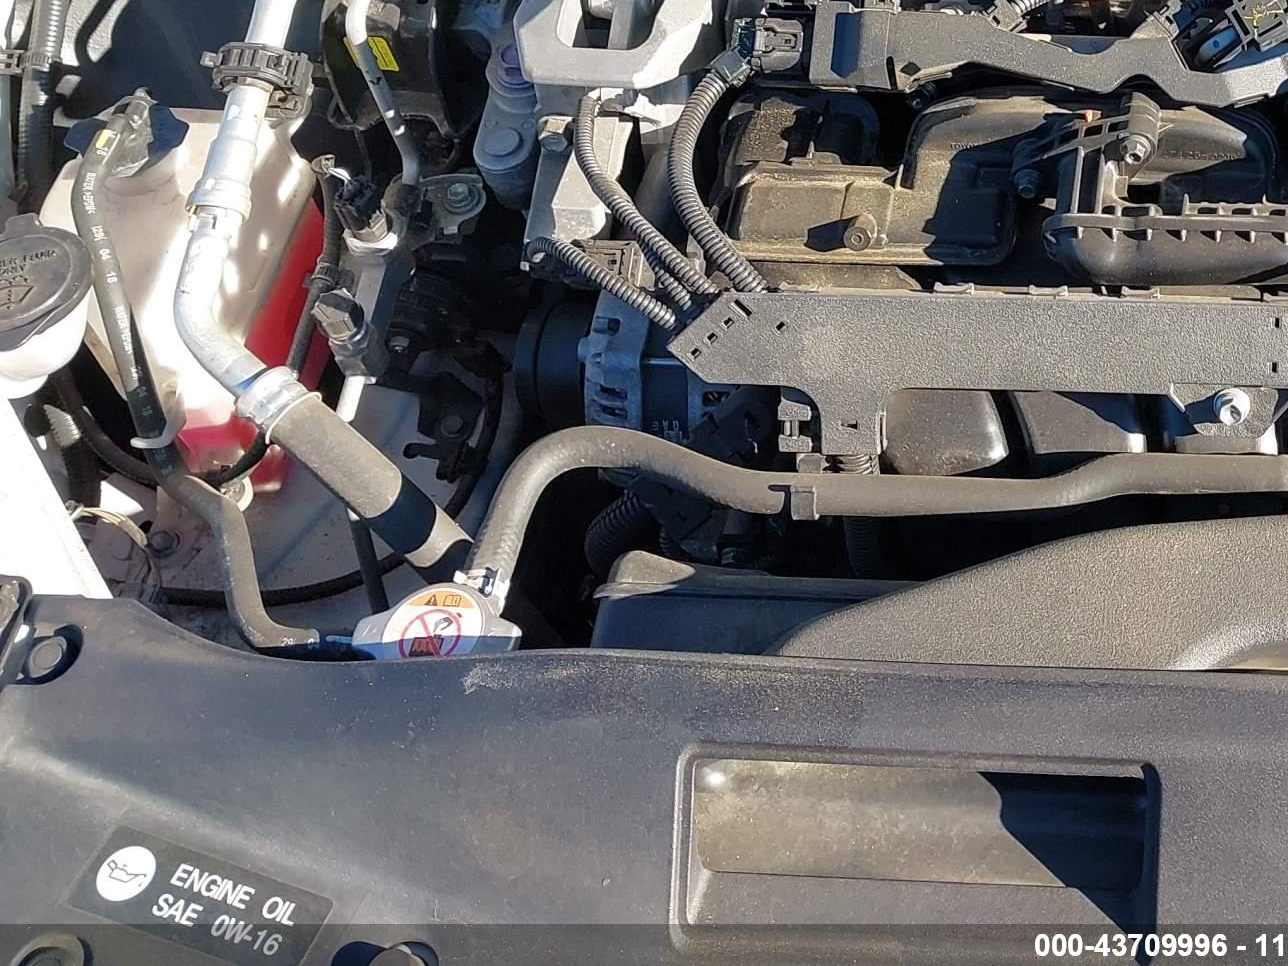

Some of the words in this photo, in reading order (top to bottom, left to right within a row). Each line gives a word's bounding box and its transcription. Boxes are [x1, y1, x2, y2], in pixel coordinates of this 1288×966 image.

[106, 271, 118, 284] 18
[152, 893, 203, 928] SAE
[210, 914, 284, 956] 0W-16
[169, 863, 255, 910] ENGINE
[261, 896, 296, 926] OIL
